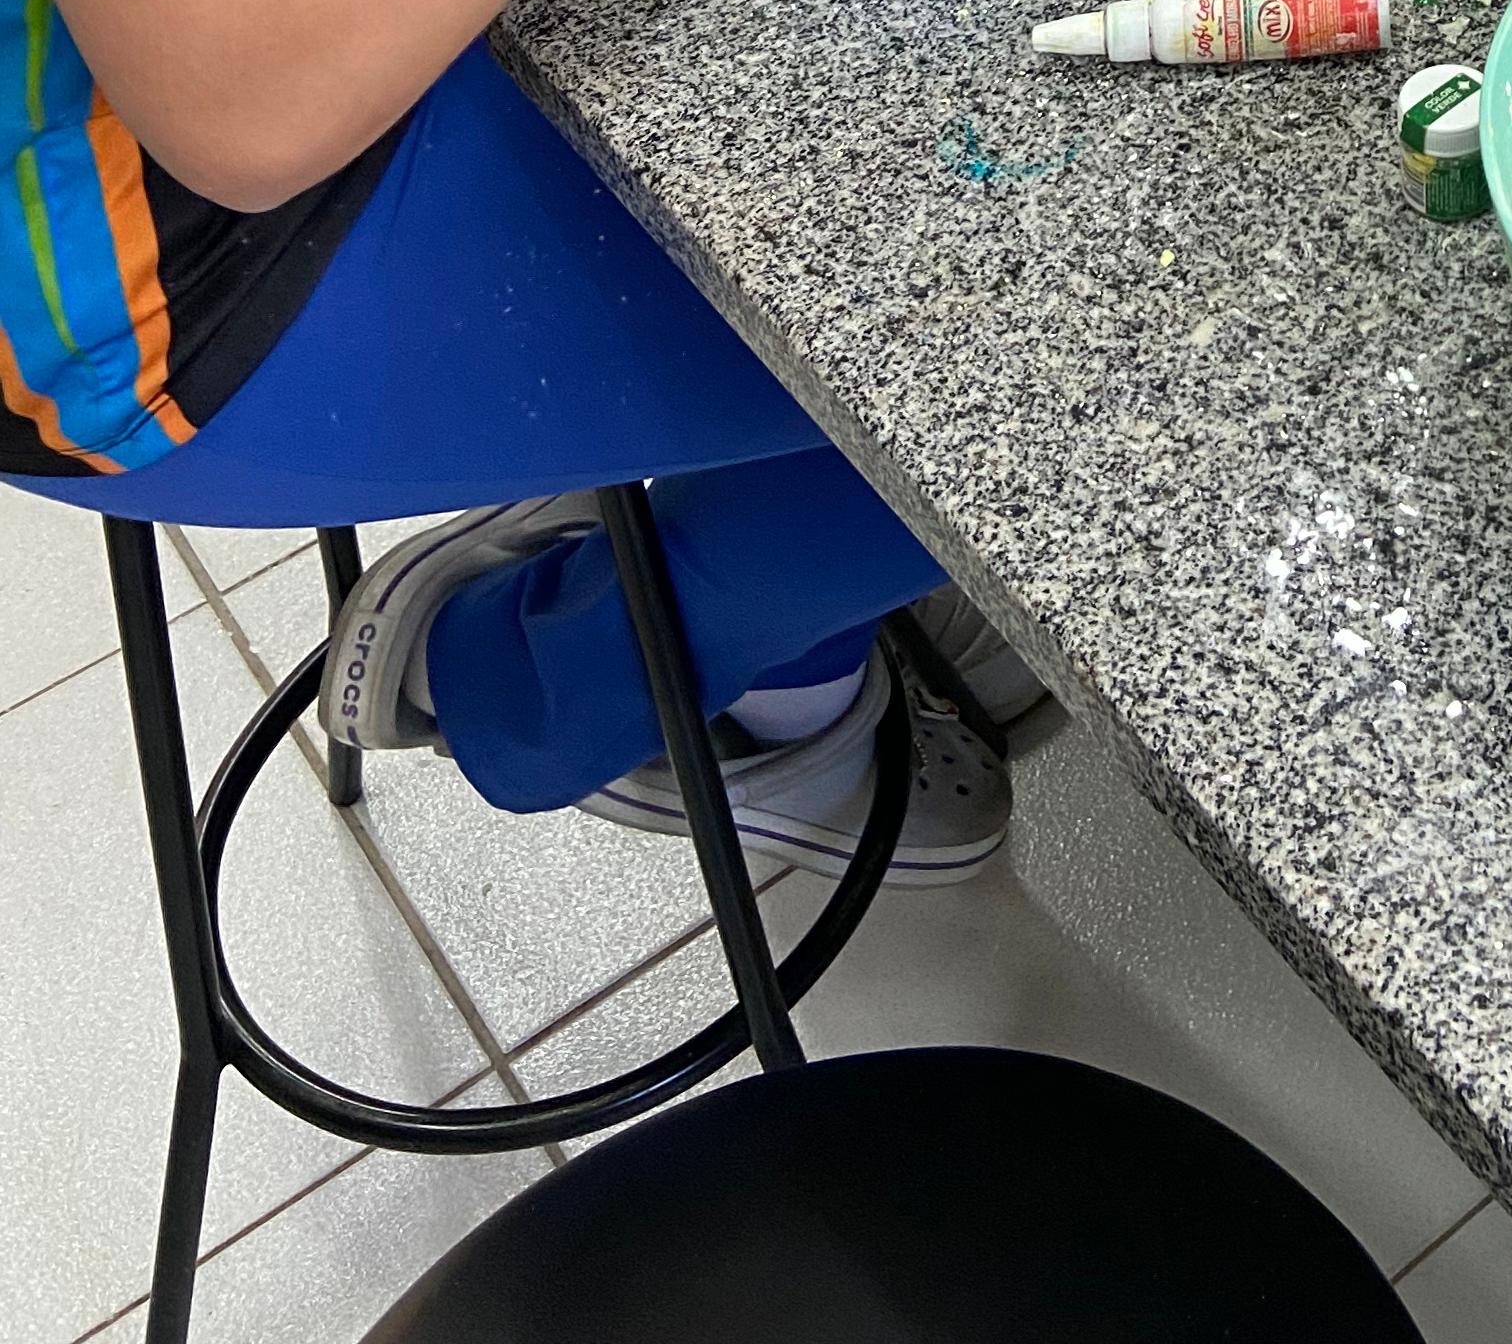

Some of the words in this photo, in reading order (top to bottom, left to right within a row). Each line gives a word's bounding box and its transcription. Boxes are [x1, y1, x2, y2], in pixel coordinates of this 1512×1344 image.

[1424, 86, 1455, 109] COLOR
[1432, 91, 1463, 113] VERDE
[342, 623, 376, 719] crocs
